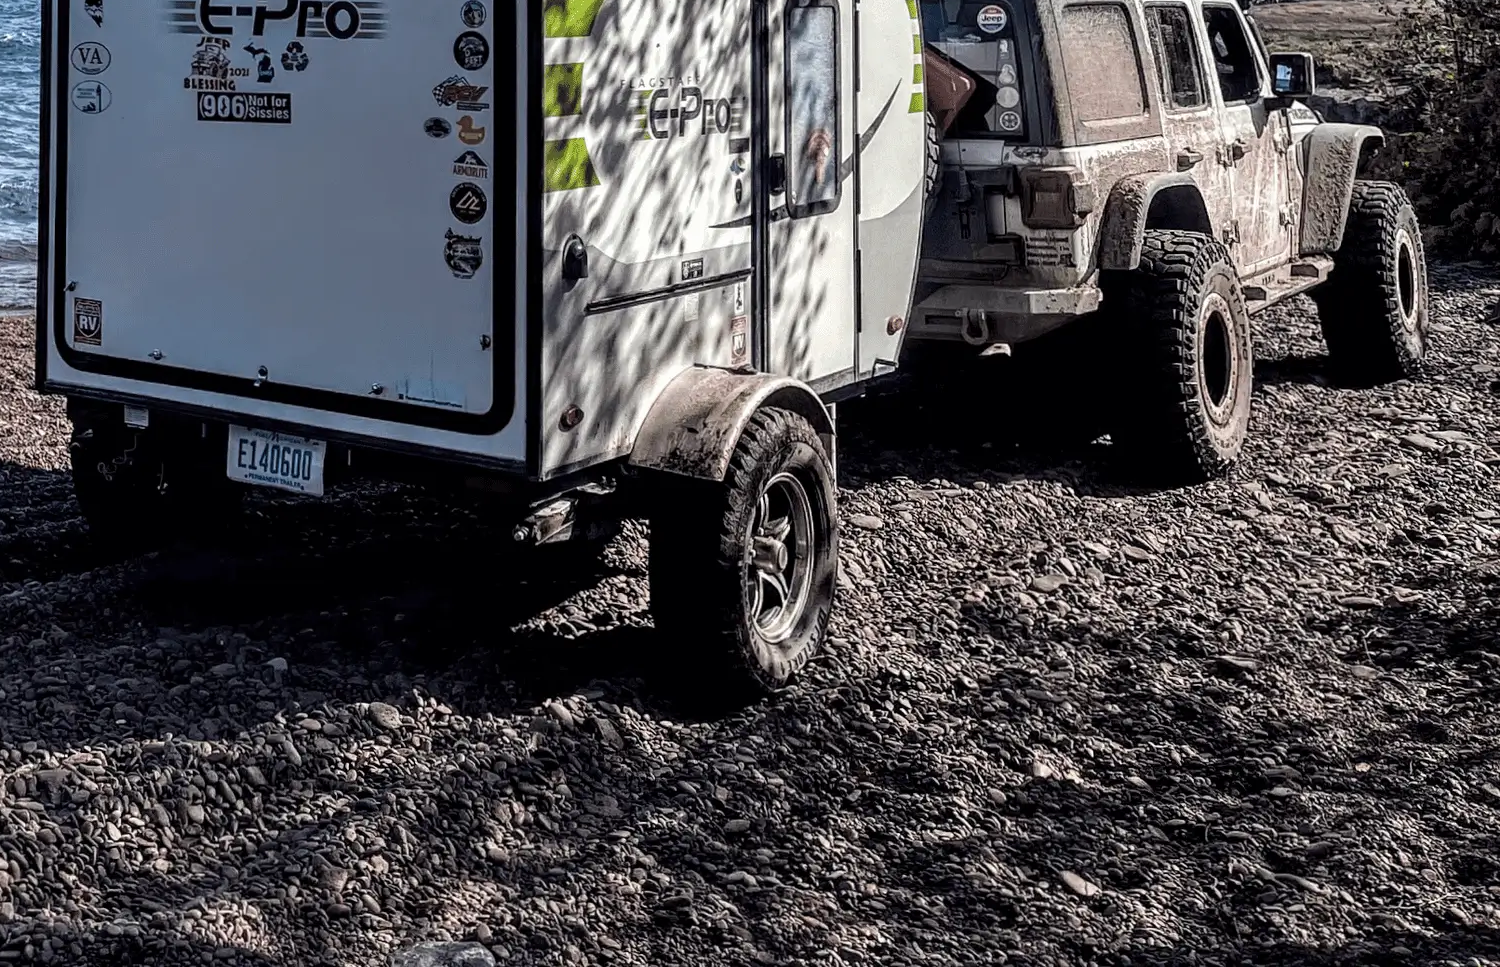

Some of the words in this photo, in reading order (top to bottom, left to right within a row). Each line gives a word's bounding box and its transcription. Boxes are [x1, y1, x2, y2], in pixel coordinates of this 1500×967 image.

[981, 14, 1003, 23] Jeep
[196, 36, 231, 51] JEEP
[77, 47, 103, 65] VA
[229, 68, 250, 77] 2021
[183, 77, 236, 91] BLESSING
[620, 75, 701, 89] FLAGSTAFF
[249, 95, 268, 107] Not
[271, 96, 288, 107] for
[249, 107, 290, 119] Sissies
[649, 86, 731, 139] E-Pro
[79, 315, 97, 331] RV
[237, 438, 313, 481] E140600
